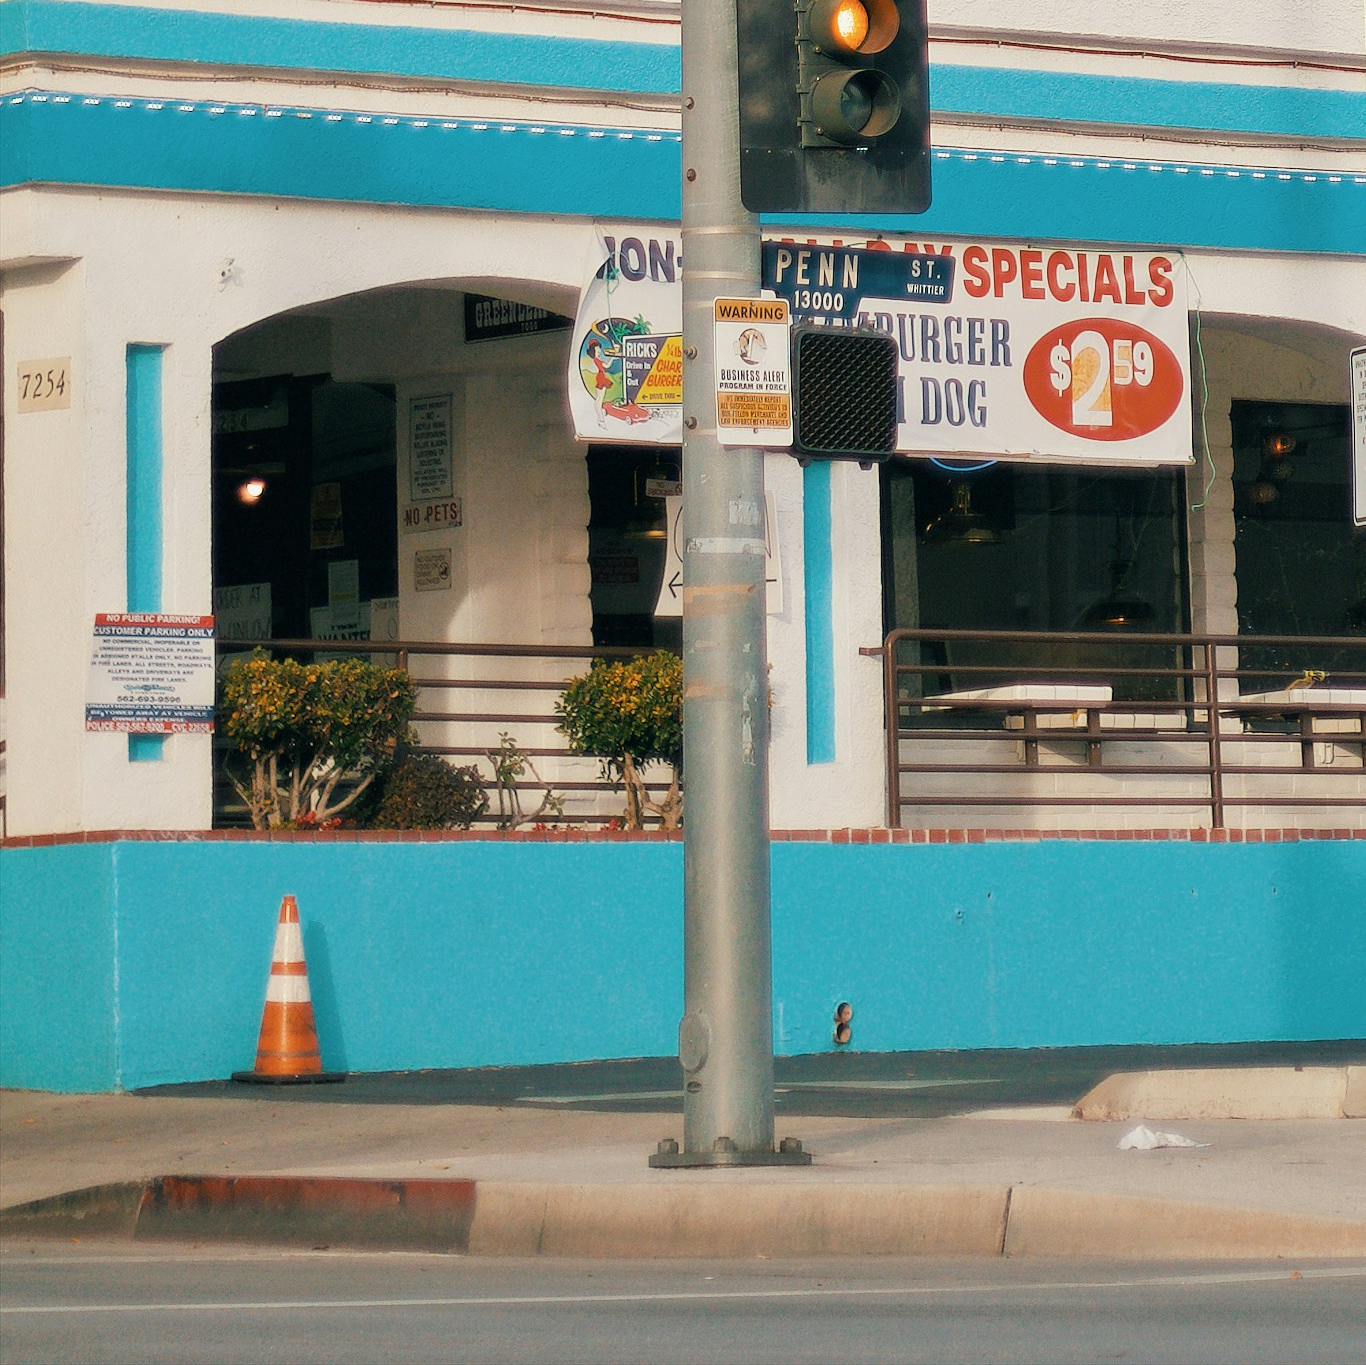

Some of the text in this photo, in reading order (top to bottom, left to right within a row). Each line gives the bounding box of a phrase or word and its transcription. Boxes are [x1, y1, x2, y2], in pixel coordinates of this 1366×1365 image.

[775, 249, 942, 289] PENN ST.
[963, 246, 1174, 307] SPECIALS
[907, 283, 945, 296] WHITTIER
[794, 290, 844, 312] 13000
[719, 305, 784, 320] WARNING
[647, 375, 682, 387] BURGER
[721, 369, 785, 383] BUSINESS ALERT
[22, 370, 65, 400] 7254
[720, 382, 753, 390] PROGRAM
[765, 383, 787, 391] FORCE
[920, 377, 987, 427] DOG
[405, 502, 457, 526] NO PETS
[106, 614, 200, 624] NO PUBLIC PARKING!
[94, 626, 142, 635] CUSTOMER
[144, 627, 185, 636] PARKING
[187, 628, 213, 636] ONLY
